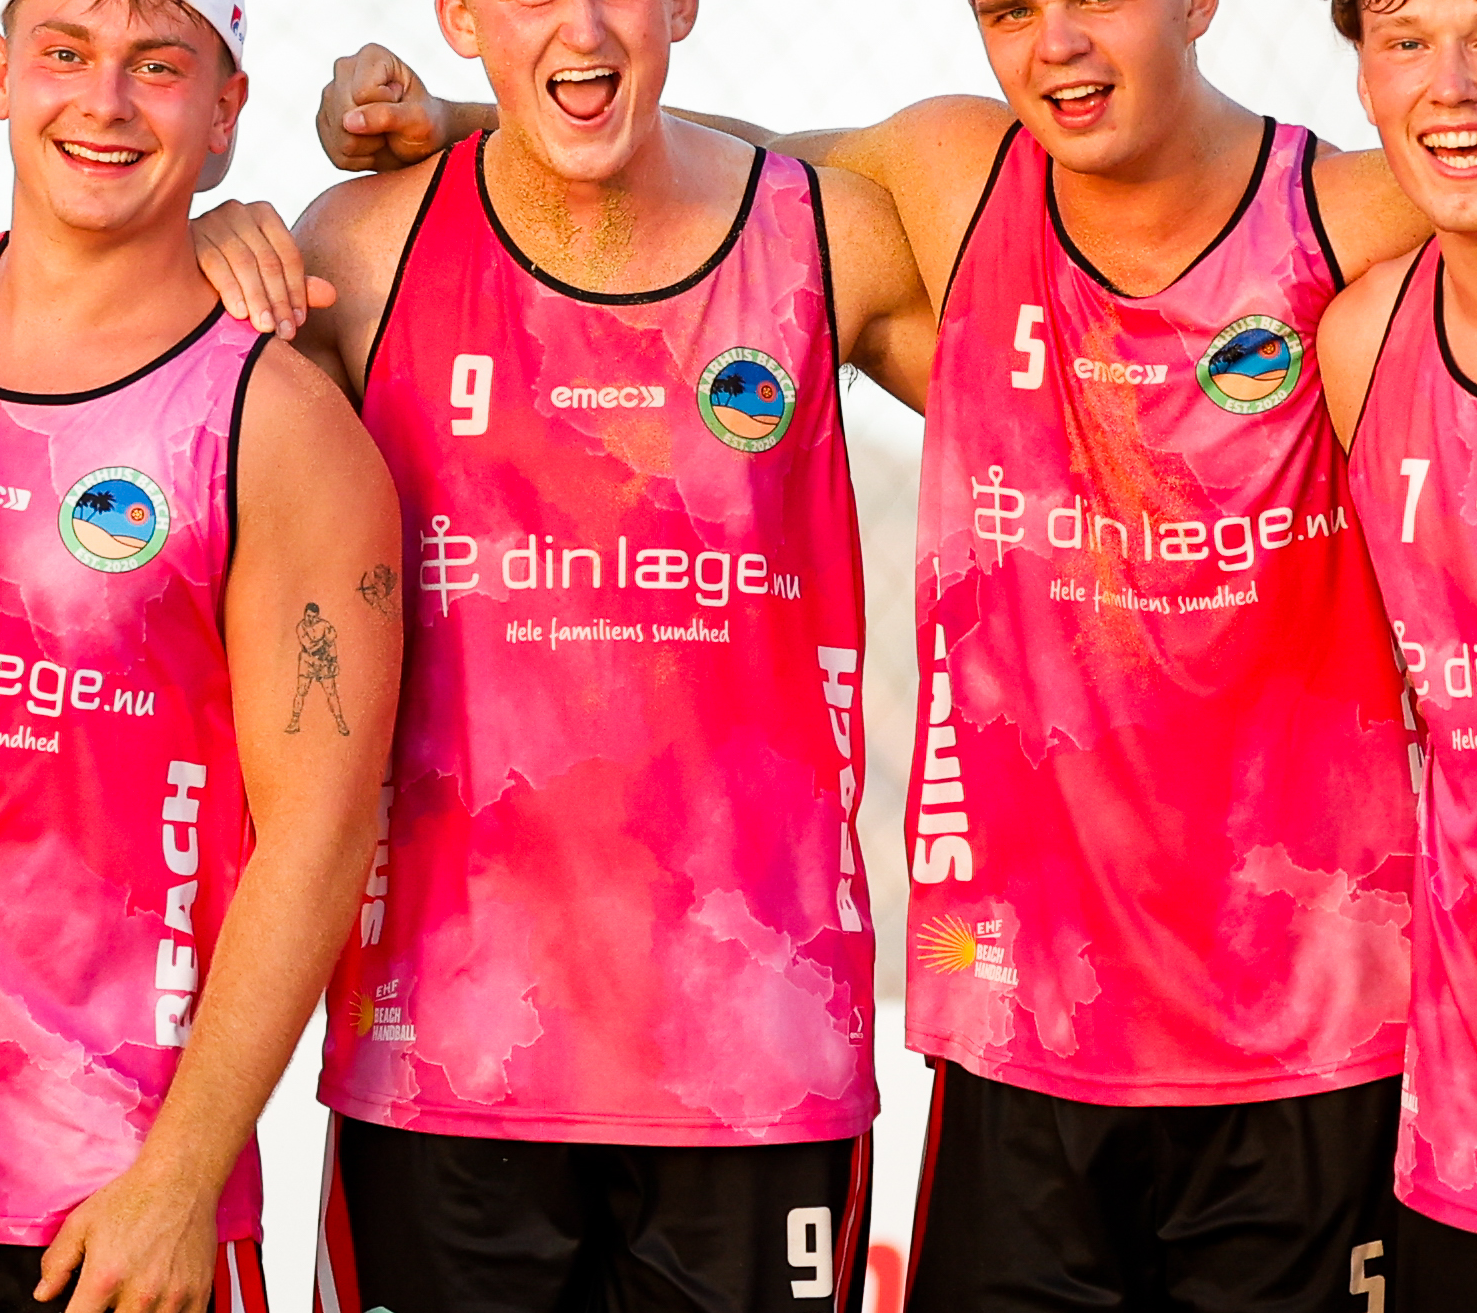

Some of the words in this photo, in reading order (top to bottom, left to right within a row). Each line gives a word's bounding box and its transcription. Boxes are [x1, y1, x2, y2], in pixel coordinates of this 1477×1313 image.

[1011, 303, 1046, 390] 5
[700, 347, 754, 397] AARHUS
[757, 350, 797, 405] BEACH
[450, 353, 494, 436] 9
[550, 385, 640, 410] emec
[1224, 397, 1253, 414] EST.
[1255, 388, 1289, 412] 2020
[751, 434, 778, 452] 2020
[64, 467, 135, 507] AARHUS
[137, 469, 169, 531] BEACH
[1400, 458, 1431, 543] 7
[104, 557, 139, 574] 2020
[1050, 578, 1086, 602] Hele
[1093, 578, 1172, 615] familiens
[1178, 580, 1260, 612] sundhed
[506, 620, 543, 644] Hele
[549, 617, 644, 651] familiens
[652, 619, 731, 644] sundhed
[154, 759, 207, 1049] BEACH
[977, 919, 1002, 935] EHF
[976, 943, 1004, 965] BEACH
[975, 961, 1019, 986] HANDBALL
[376, 979, 399, 998] EHF
[374, 1007, 402, 1024] BEACH
[372, 1024, 417, 1042] HANDBALL
[786, 1206, 834, 1299] 9
